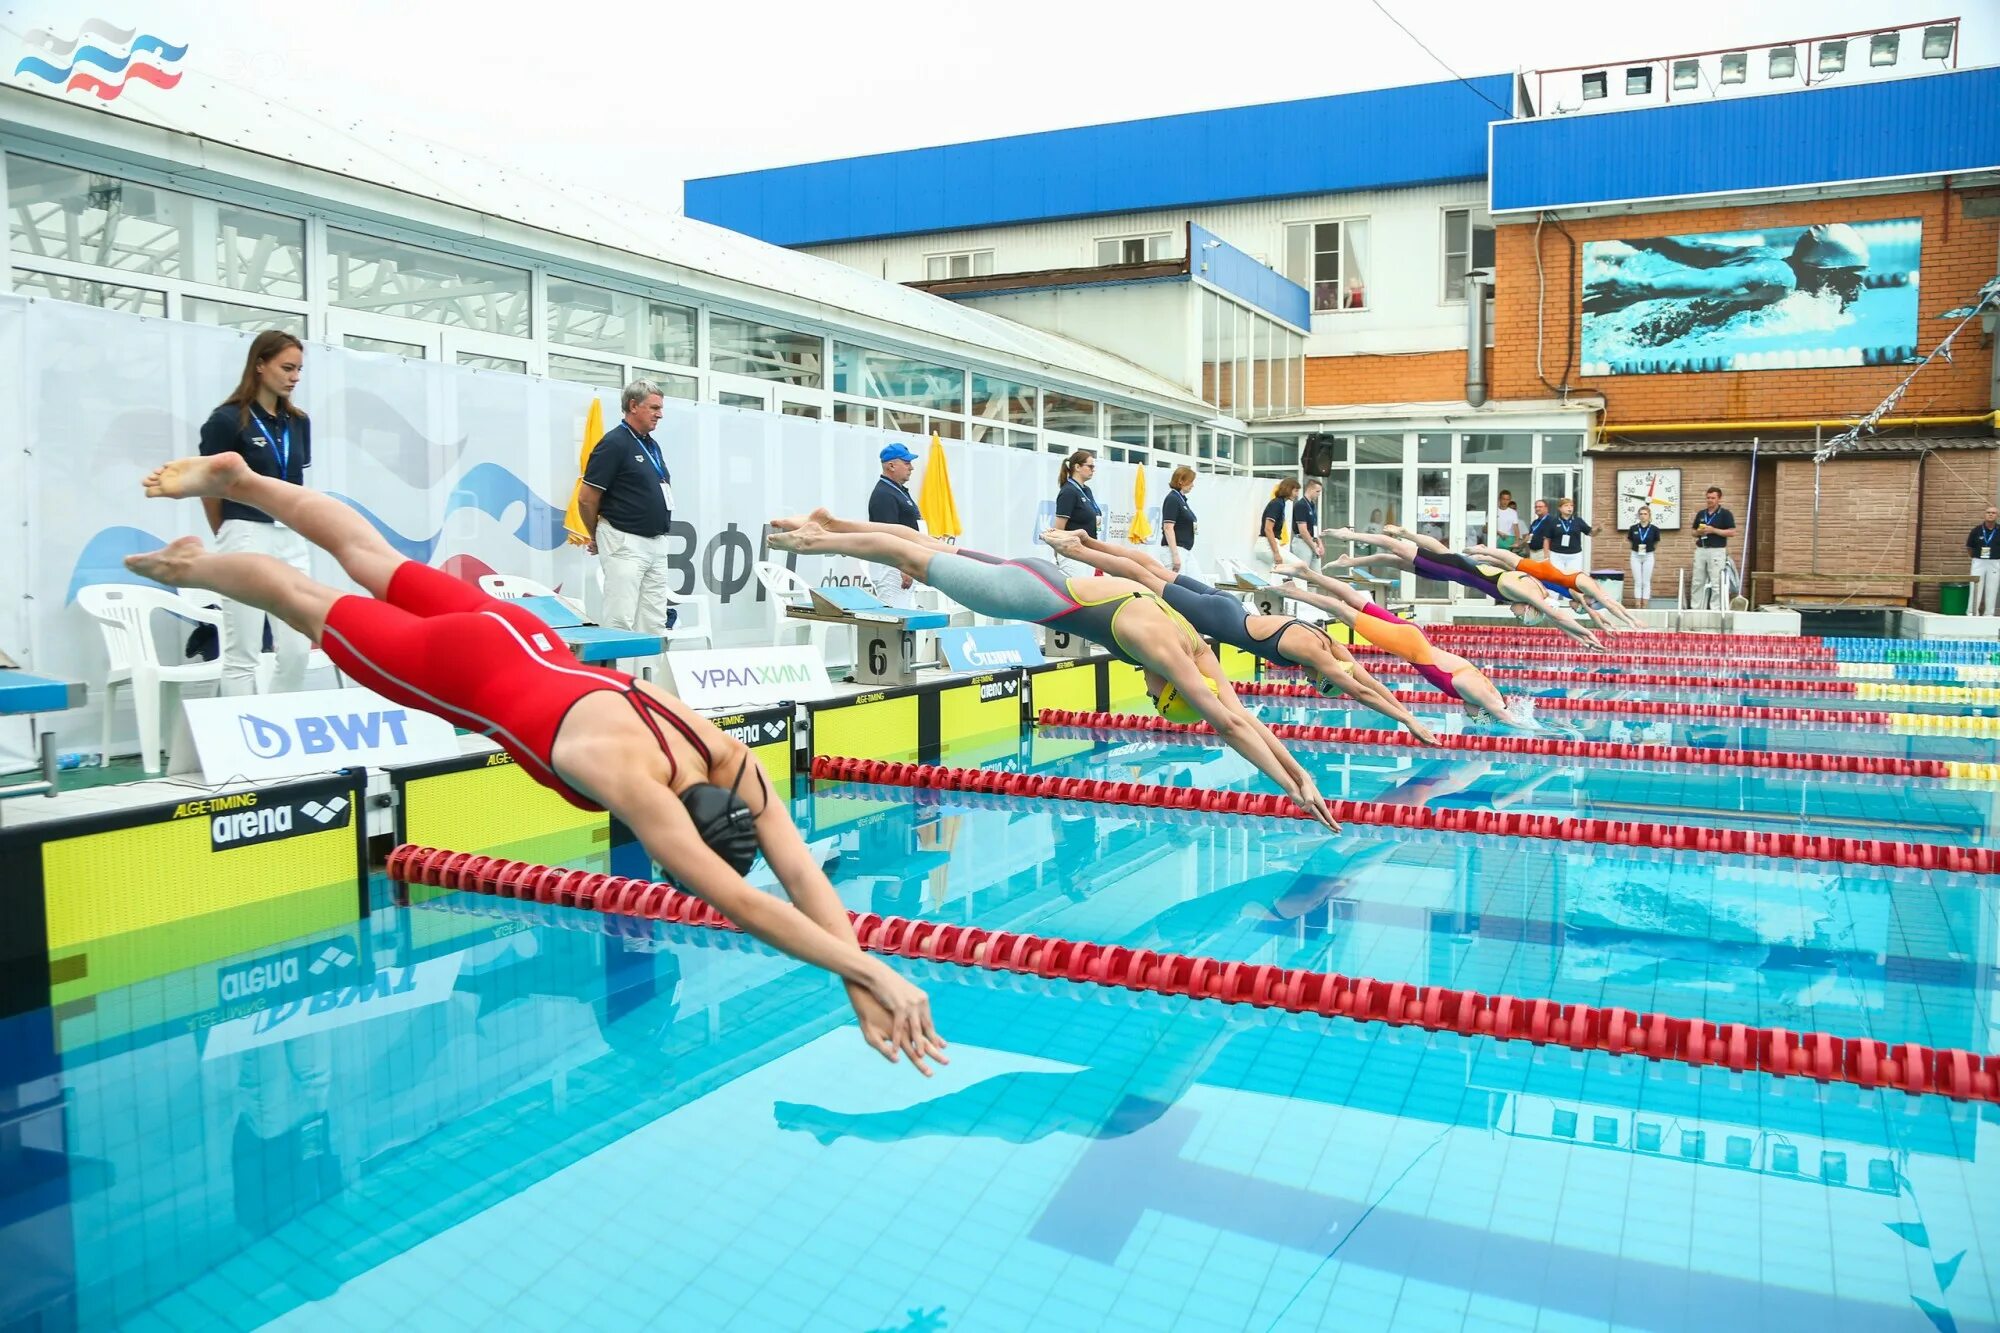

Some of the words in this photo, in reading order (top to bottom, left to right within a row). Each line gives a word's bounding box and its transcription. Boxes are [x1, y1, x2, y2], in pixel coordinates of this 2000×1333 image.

[1054, 631, 1070, 649] 5
[868, 638, 888, 676] 6
[691, 663, 812, 689] УРАЛХИМ
[981, 682, 1002, 699] arena
[295, 710, 408, 754] BWT
[713, 714, 744, 728] GE-TIMING
[725, 724, 760, 743] rena
[173, 793, 257, 819] ALGE-TIMING
[212, 805, 293, 844] arena
